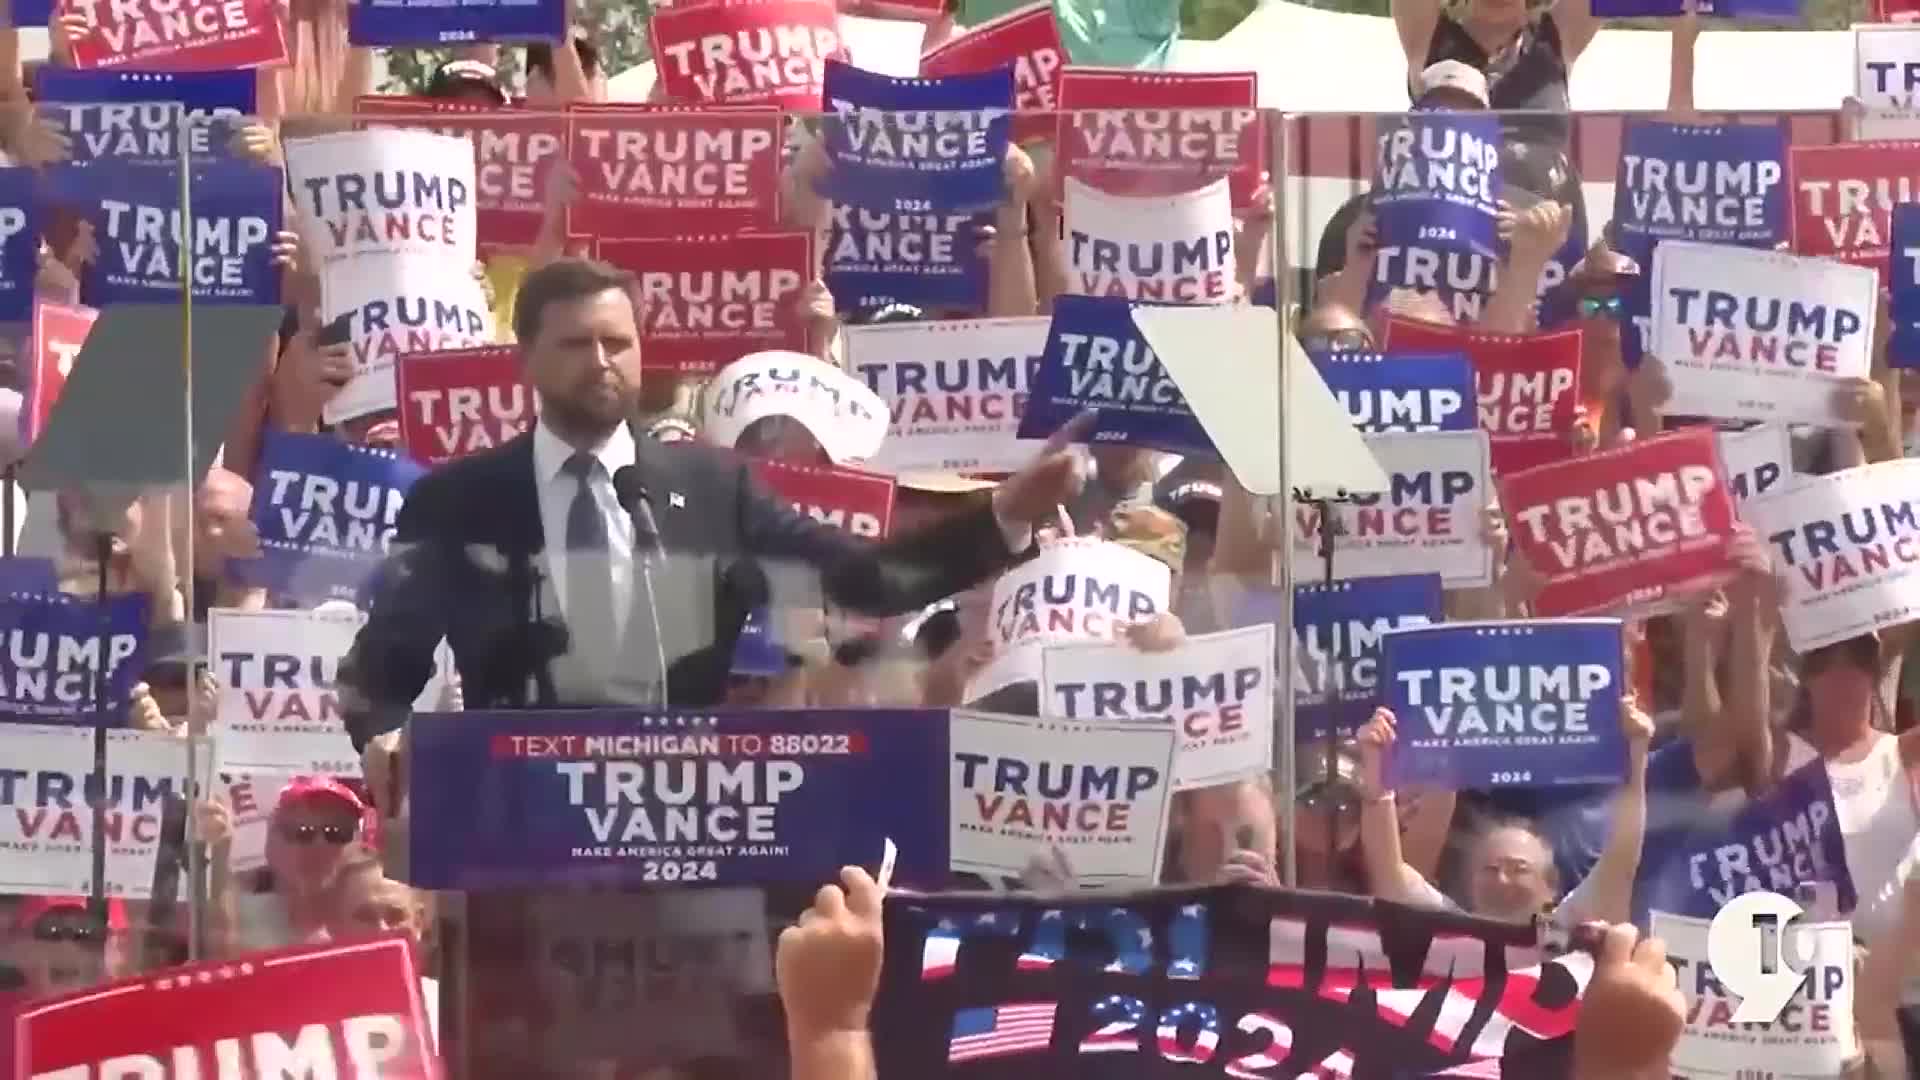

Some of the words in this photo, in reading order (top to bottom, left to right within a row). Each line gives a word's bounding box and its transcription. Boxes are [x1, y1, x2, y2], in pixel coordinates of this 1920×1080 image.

[100, 0, 250, 52] VANCE
[664, 25, 838, 76] TRUMP
[84, 127, 209, 158] VANE
[580, 127, 772, 163] TRUMP
[847, 125, 987, 159] VANCE
[1083, 129, 1240, 160] VANCE
[1377, 126, 1499, 174] TRUMP
[304, 169, 467, 218] TRUMP
[601, 163, 749, 195] VANCE
[1623, 155, 1781, 197] TRUMP
[1632, 192, 1764, 226] VANCE
[1801, 176, 1920, 216] TRU
[326, 213, 457, 247] VANCE
[833, 231, 953, 261] ANCE
[1071, 230, 1231, 277] TRUMP
[1375, 245, 1565, 297] TRUP
[642, 269, 800, 302] RUMP
[1080, 271, 1226, 301] VANCE
[643, 303, 775, 329] ANCE
[1669, 287, 1861, 343] TRUMP
[1060, 332, 1167, 376] TRU
[1688, 327, 1839, 373] VANCE
[410, 384, 542, 425] TRU
[1070, 369, 1188, 405] VANC
[1476, 368, 1574, 405] UMP
[1336, 388, 1463, 426] UMP
[1478, 404, 1555, 433] NCE
[1519, 464, 1714, 543] TRUMP
[1550, 504, 1706, 569] VANCE
[1770, 500, 1920, 565] TRUM
[1803, 537, 1919, 592] VANC
[998, 574, 1156, 620] TRUMP
[1000, 605, 1110, 642] VANC
[2, 628, 138, 673] UMP
[220, 652, 338, 691] TRU
[1396, 664, 1612, 707] TRUMP
[1055, 666, 1262, 719] TRUMP
[1423, 702, 1591, 736] VANCE
[511, 735, 578, 757] TEXT
[585, 735, 720, 757] MICHIGAN
[730, 735, 762, 757] TO
[770, 734, 850, 755] 88022
[0, 769, 188, 812] TRUM
[556, 760, 805, 805] TRUMP
[955, 752, 1160, 801] TRUMP
[16, 808, 158, 844] VANC
[584, 806, 776, 843] VANCE
[975, 793, 1132, 832] VANCE
[571, 847, 612, 857] MAKE
[616, 847, 681, 857] AMERICA
[686, 847, 733, 857] GREAT
[738, 847, 790, 857] AGAIN!
[1689, 799, 1829, 890] TRUMP
[642, 860, 717, 881] 2024
[1708, 852, 1824, 908] VANC
[1686, 999, 1831, 1033] ACE
